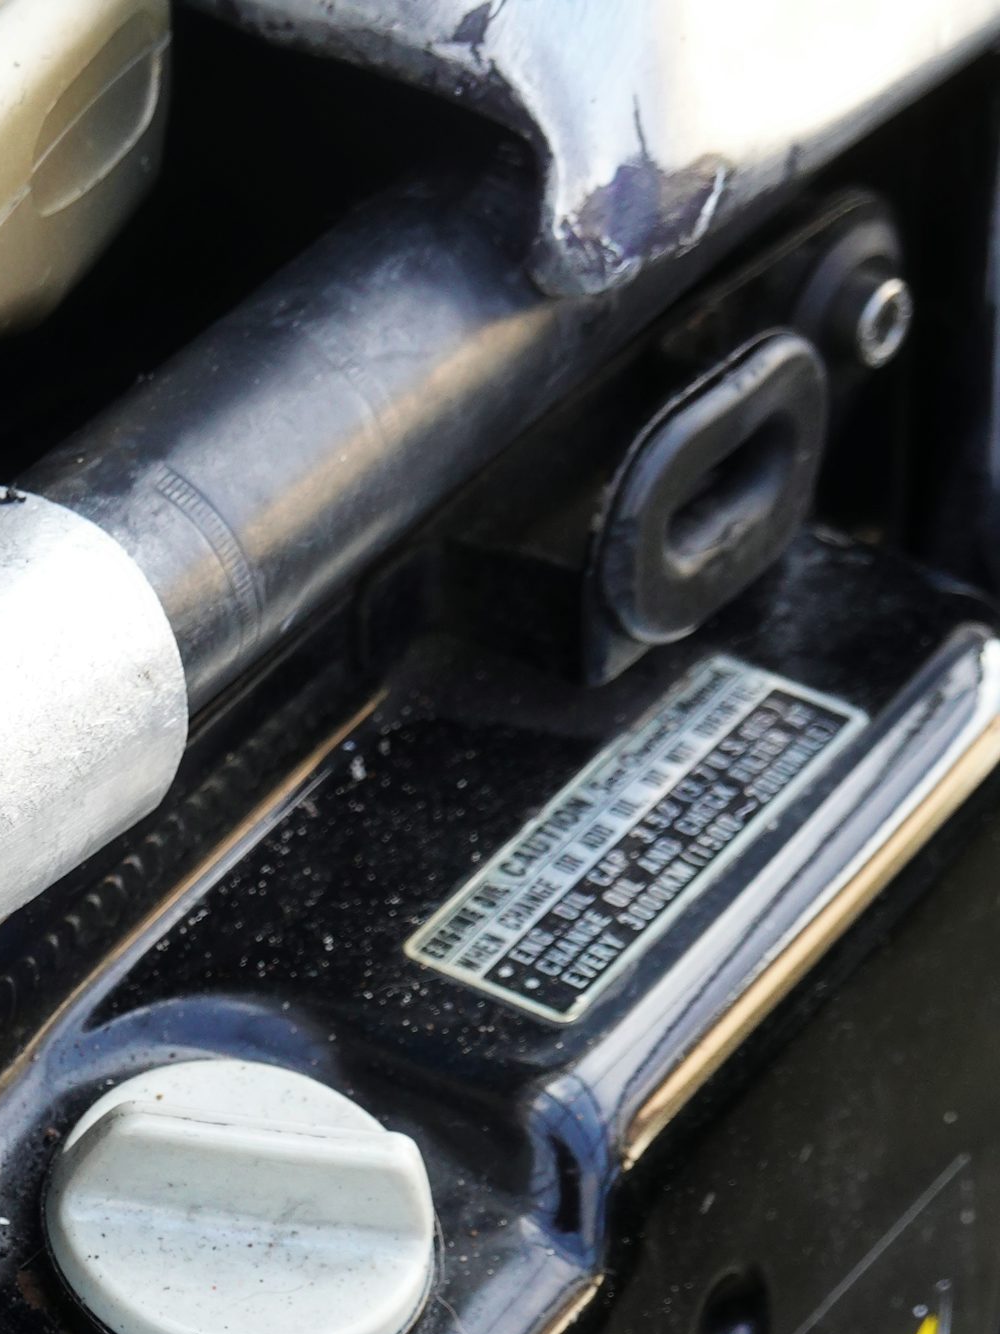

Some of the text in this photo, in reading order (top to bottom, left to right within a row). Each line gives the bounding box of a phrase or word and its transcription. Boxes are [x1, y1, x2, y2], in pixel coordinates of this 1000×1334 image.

[497, 797, 593, 877] CAUTION
[533, 909, 612, 976] CHANGE
[601, 875, 645, 907] OIL
[635, 836, 684, 873] AND
[673, 781, 739, 835] CHECK
[726, 728, 792, 782] FILTER
[455, 932, 506, 971] WHEN
[497, 878, 561, 930] CHANGE
[552, 888, 595, 920] OIL
[560, 932, 627, 988] EVERY
